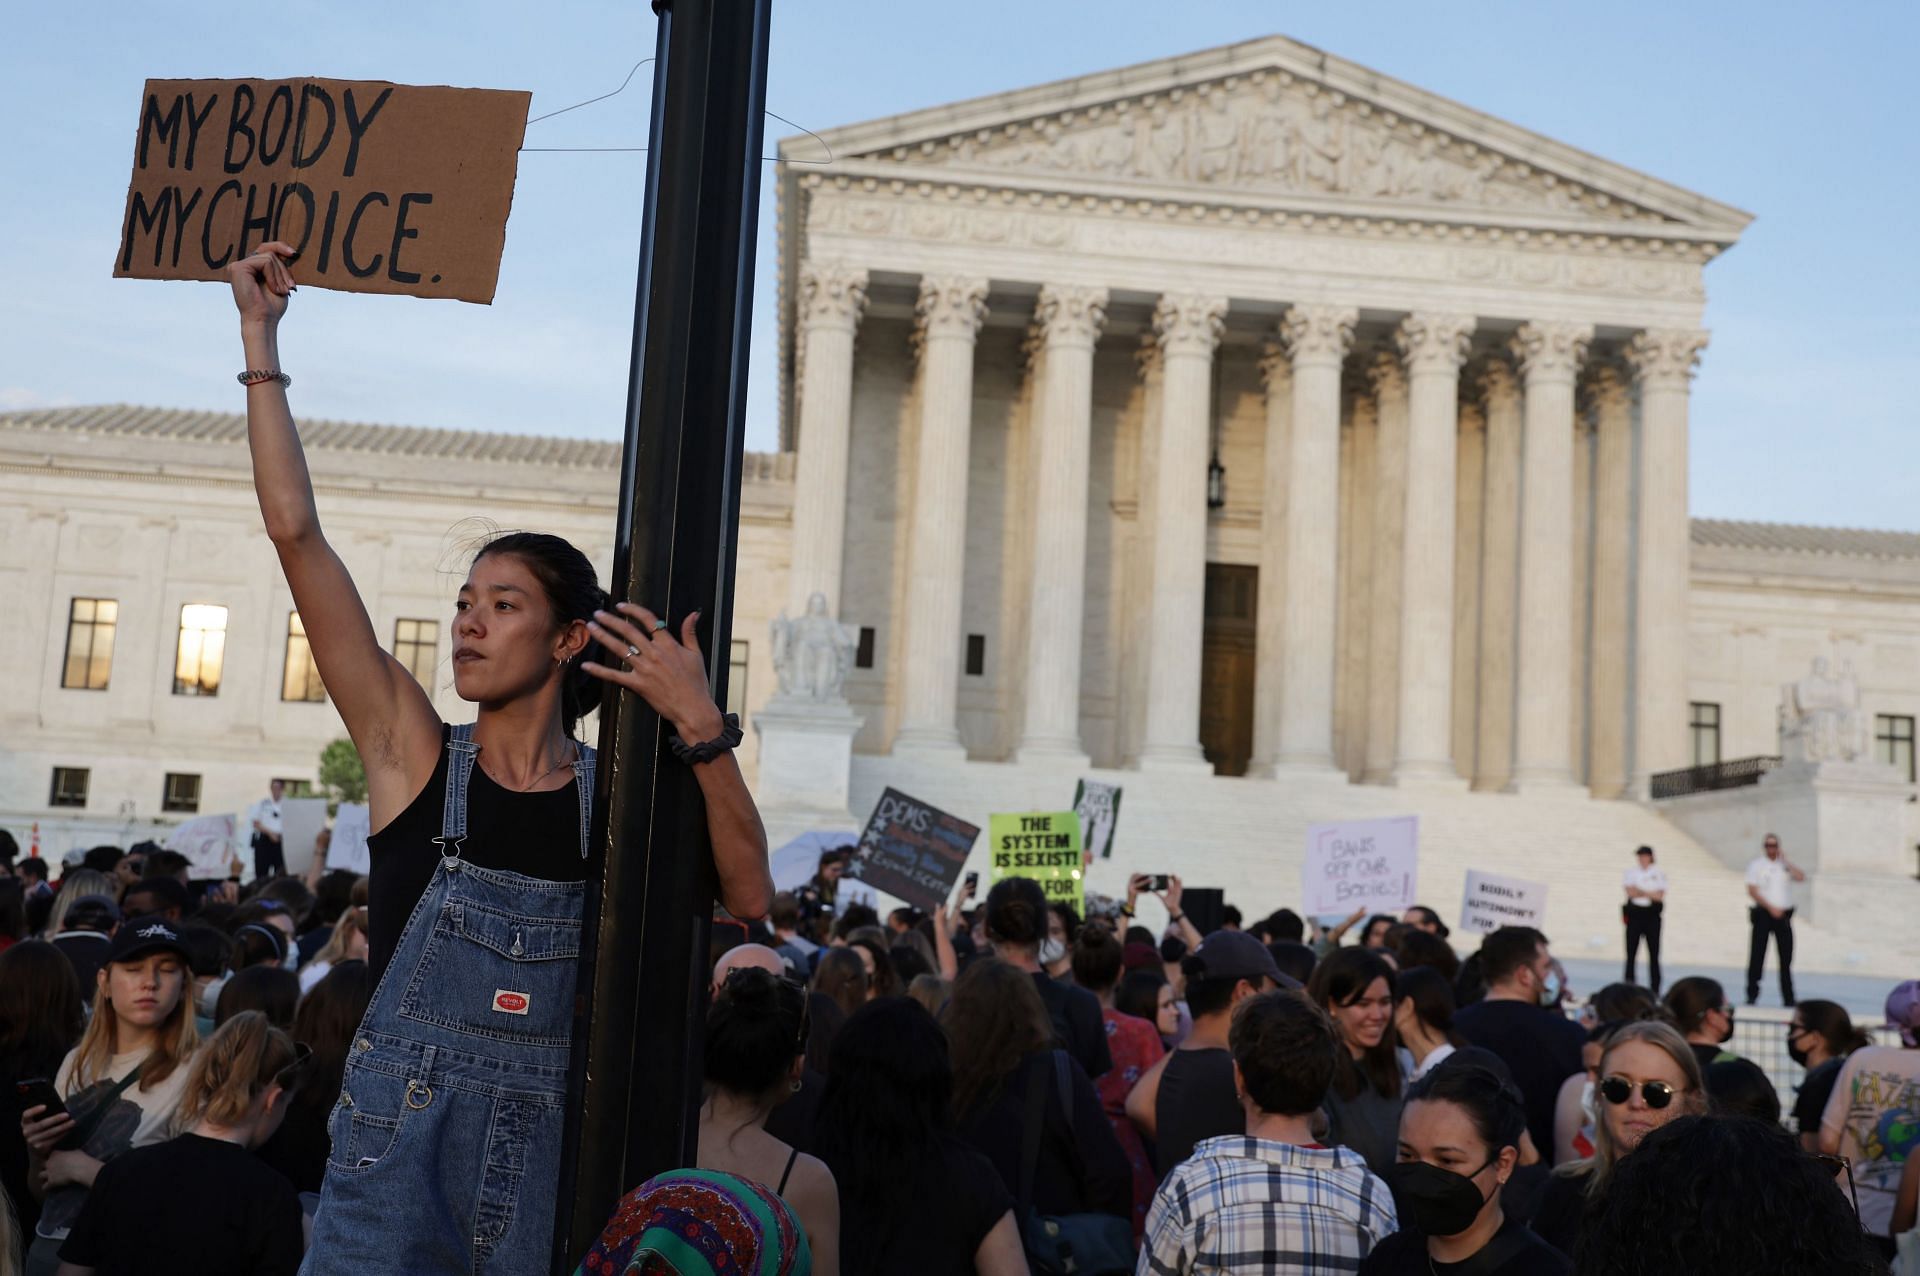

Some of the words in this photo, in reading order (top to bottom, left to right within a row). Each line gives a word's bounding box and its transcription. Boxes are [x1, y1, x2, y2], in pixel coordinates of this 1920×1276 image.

[139, 92, 217, 170] MY
[223, 83, 394, 178] BODY
[122, 186, 203, 272] MY
[1020, 816, 1052, 832] THE
[1001, 834, 1071, 850] SYSTEM
[995, 852, 1011, 867] IS
[1014, 851, 1078, 867] SEXIST!
[1045, 879, 1075, 895] FOR
